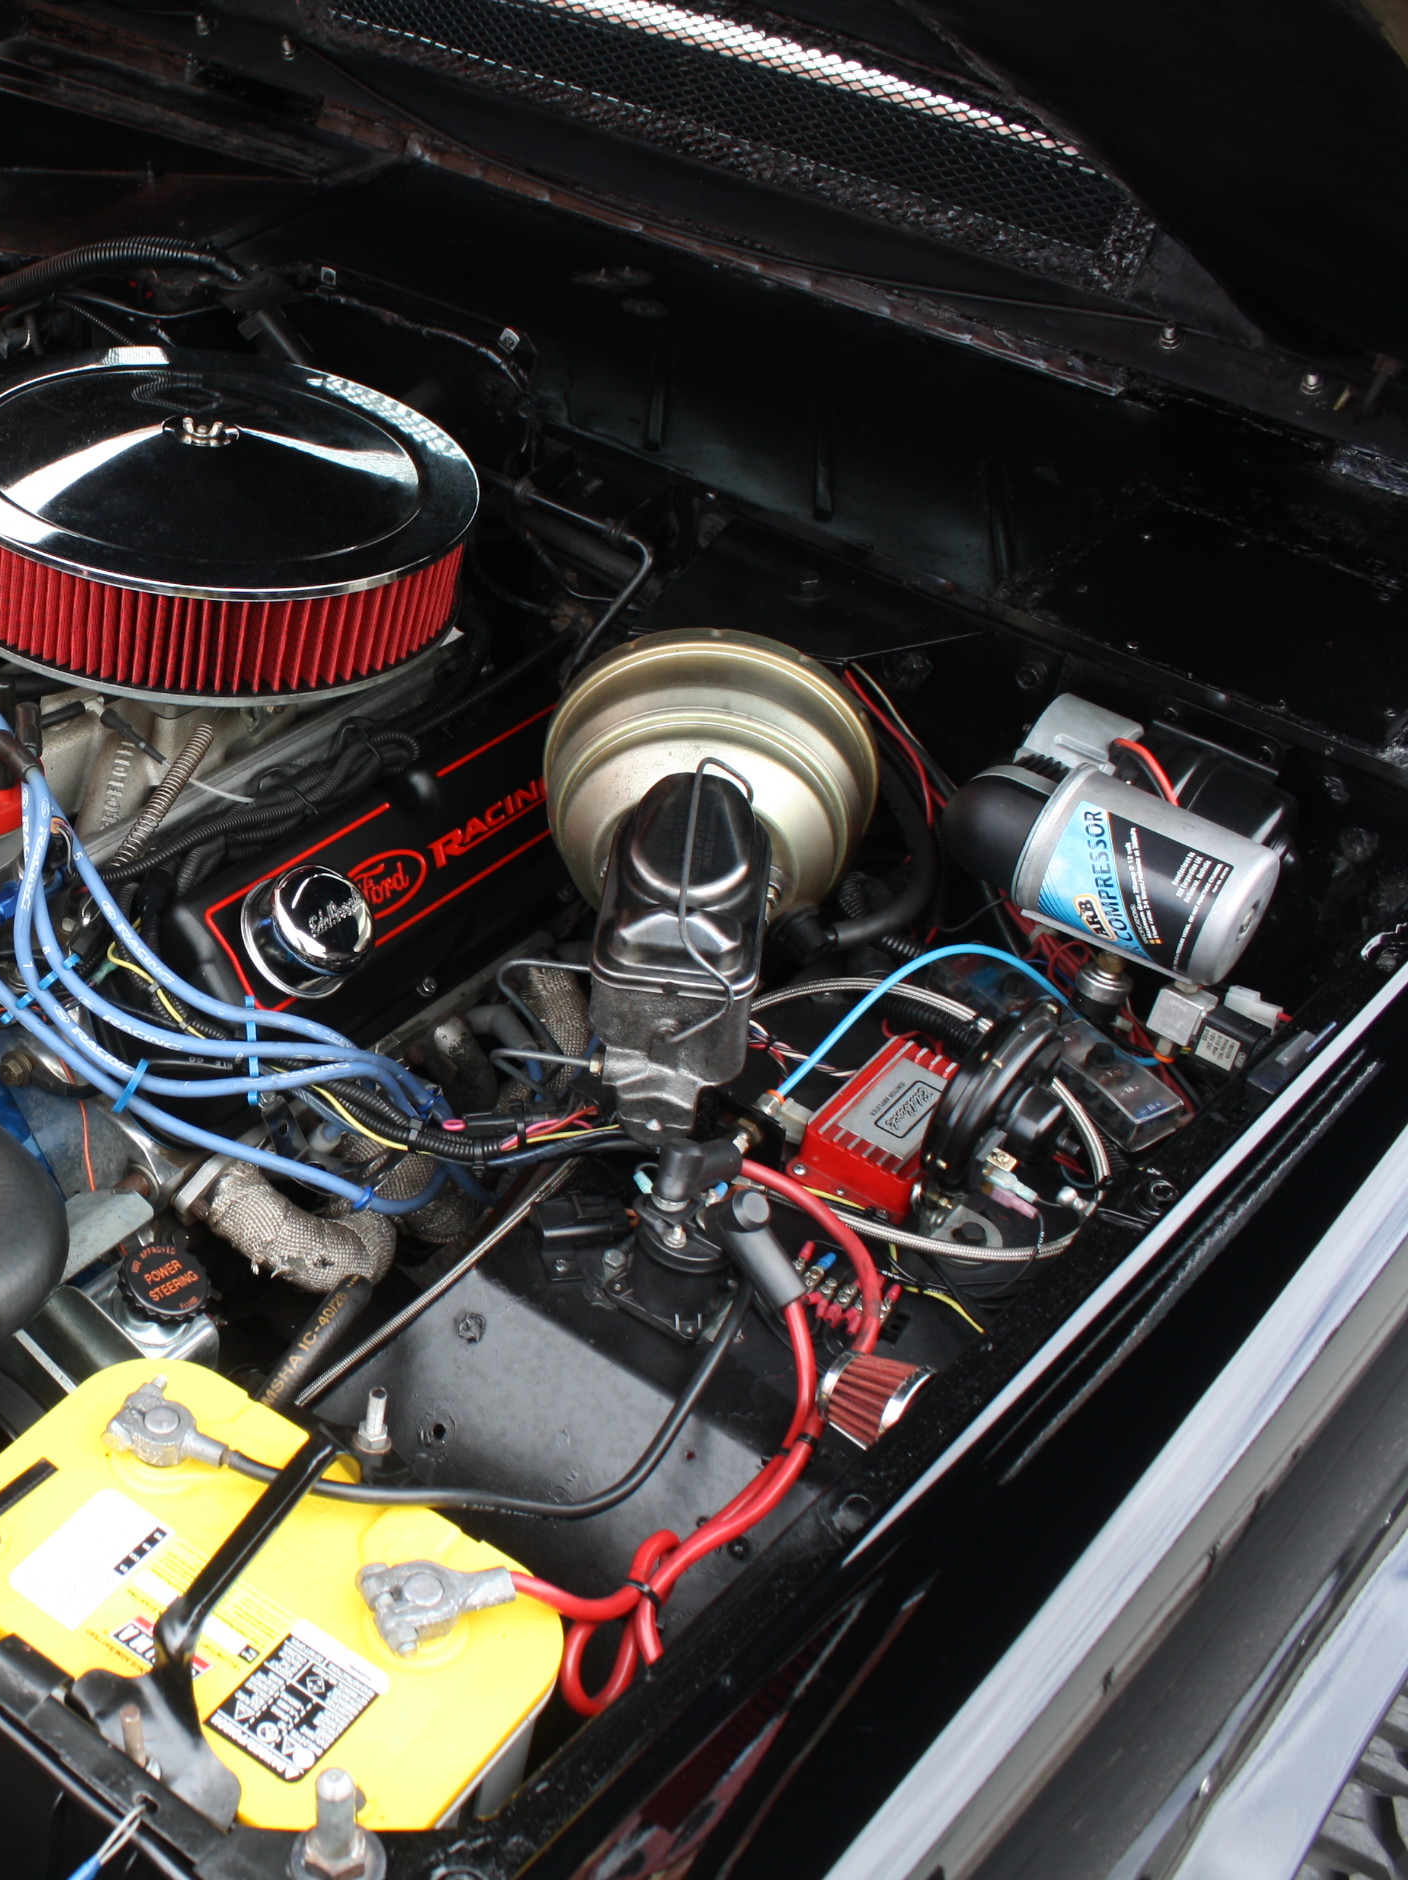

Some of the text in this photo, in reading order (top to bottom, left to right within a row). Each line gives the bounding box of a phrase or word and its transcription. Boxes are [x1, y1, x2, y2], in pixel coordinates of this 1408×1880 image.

[21, 825, 50, 912] RACING
[355, 862, 410, 905] Ford
[1083, 809, 1134, 943] COMPRESSOR
[1077, 897, 1113, 940] ARB
[115, 923, 175, 986] RACING
[71, 1026, 135, 1075] RACING
[102, 1014, 182, 1052] RACING
[143, 1259, 183, 1285] POWER
[148, 1270, 200, 1302] STEERING
